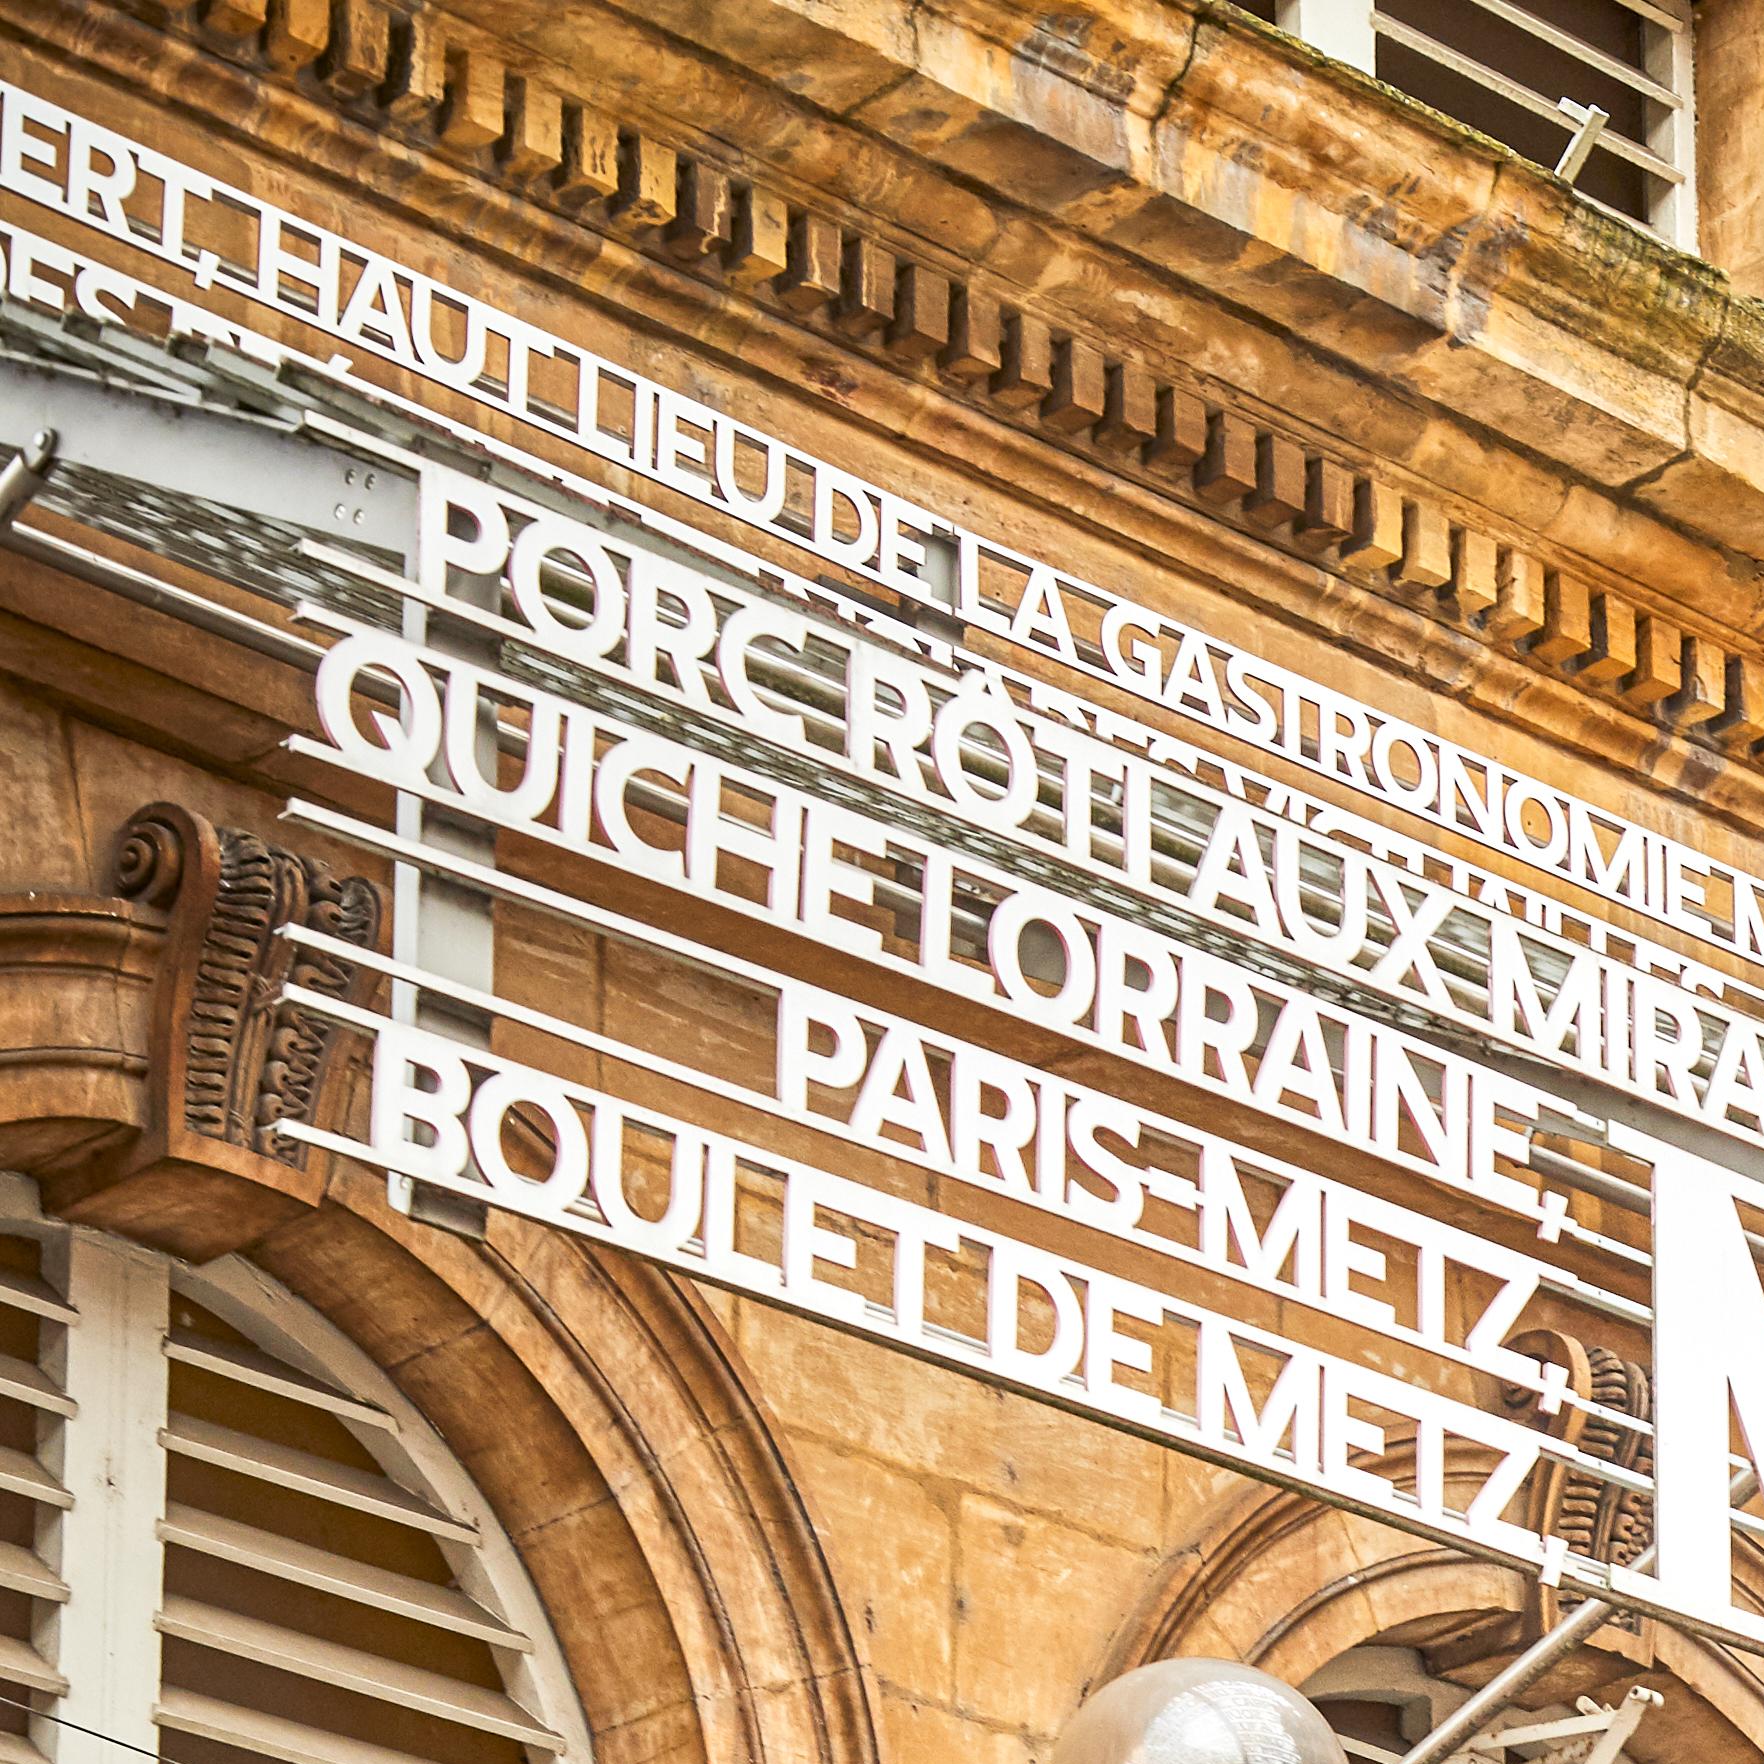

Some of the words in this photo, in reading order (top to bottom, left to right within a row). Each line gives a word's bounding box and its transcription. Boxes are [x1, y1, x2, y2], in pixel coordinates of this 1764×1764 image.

[0, 80, 220, 290] ERT,
[258, 200, 554, 434] HAUT
[577, 348, 787, 536] LIEU
[815, 460, 933, 601] DE
[958, 527, 1078, 664] LA
[1101, 592, 1711, 944] GASTRONOMIE
[419, 460, 806, 758] PORC
[848, 639, 1151, 895] RÔTI
[1190, 780, 1455, 1012] AUX
[316, 615, 883, 960] QUICHE
[921, 841, 1568, 1243] LORRAINE,
[372, 1028, 960, 1362] BOULET
[993, 1240, 1164, 1437] DE
[1201, 1324, 1568, 1586] METZ,
